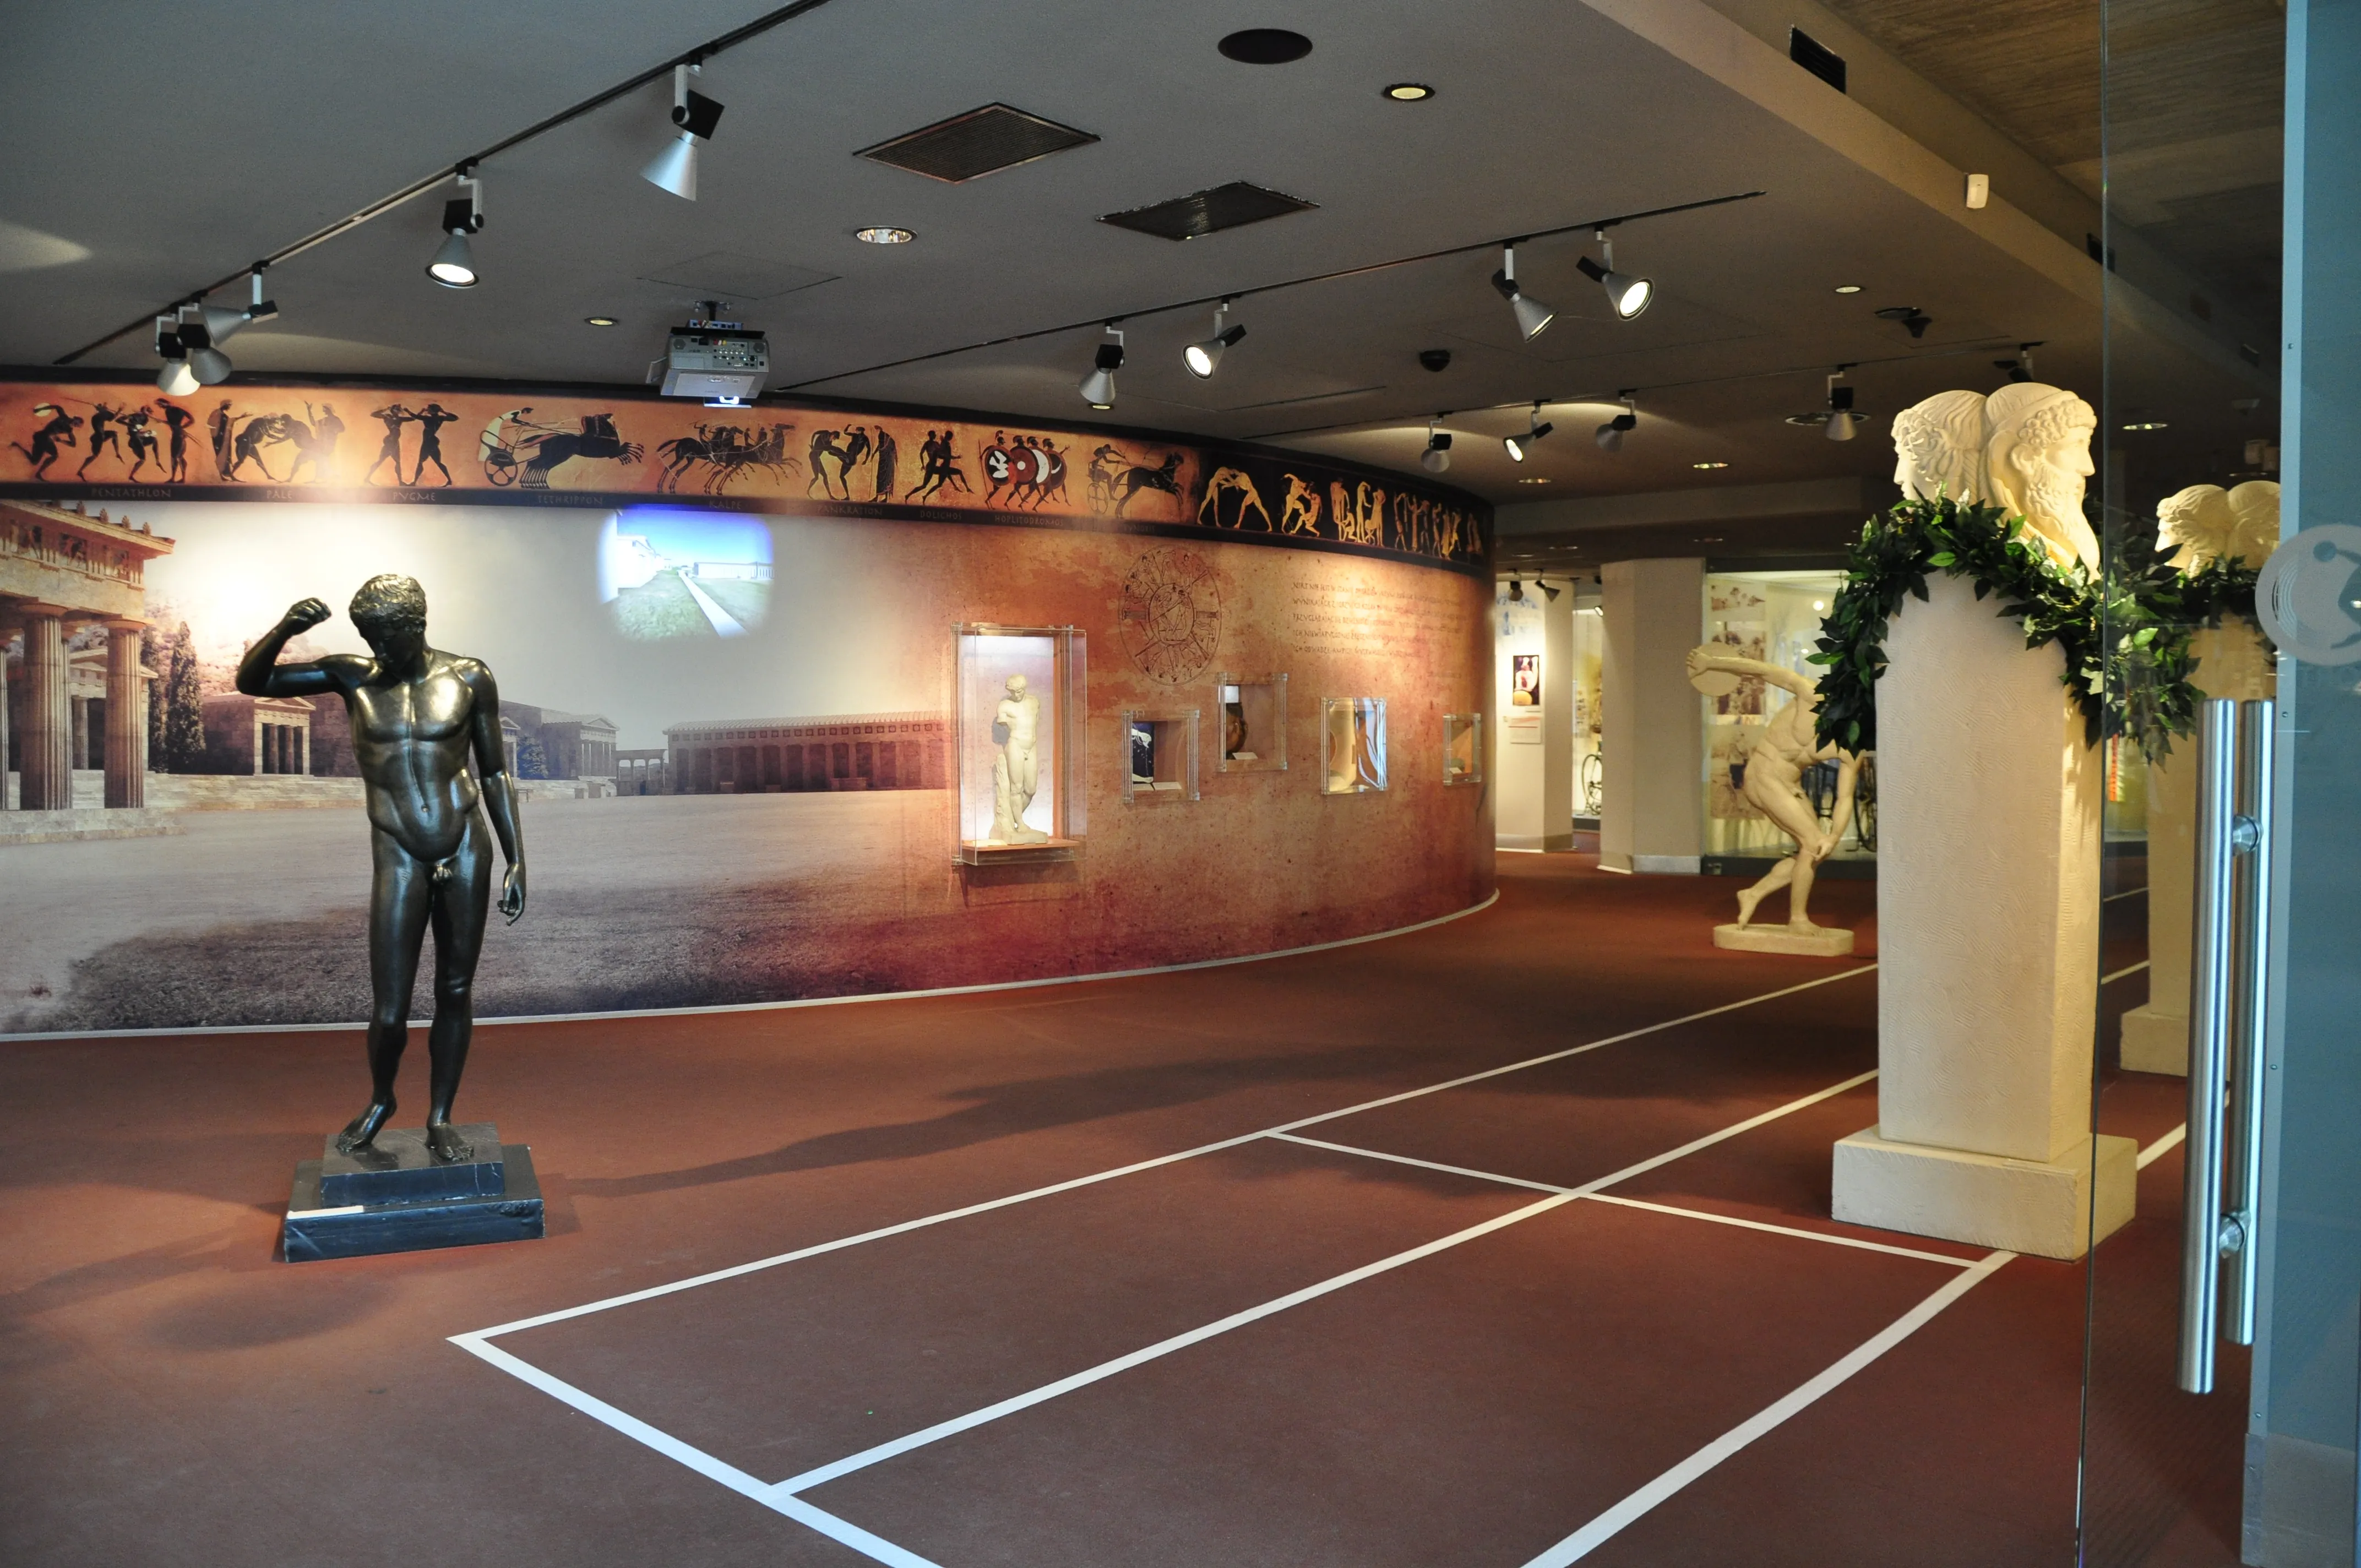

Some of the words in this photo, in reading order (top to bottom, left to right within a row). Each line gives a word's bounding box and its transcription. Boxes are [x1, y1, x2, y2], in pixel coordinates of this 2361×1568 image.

[91, 488, 171, 498] PENTATHLON
[266, 489, 292, 499] PALE
[537, 495, 602, 505] TETHRIPPON
[709, 498, 741, 509] KALPE
[817, 504, 883, 516] PANKRATION
[920, 510, 962, 520] DOLICHOS
[994, 515, 1064, 526] HOPLITODROMOS
